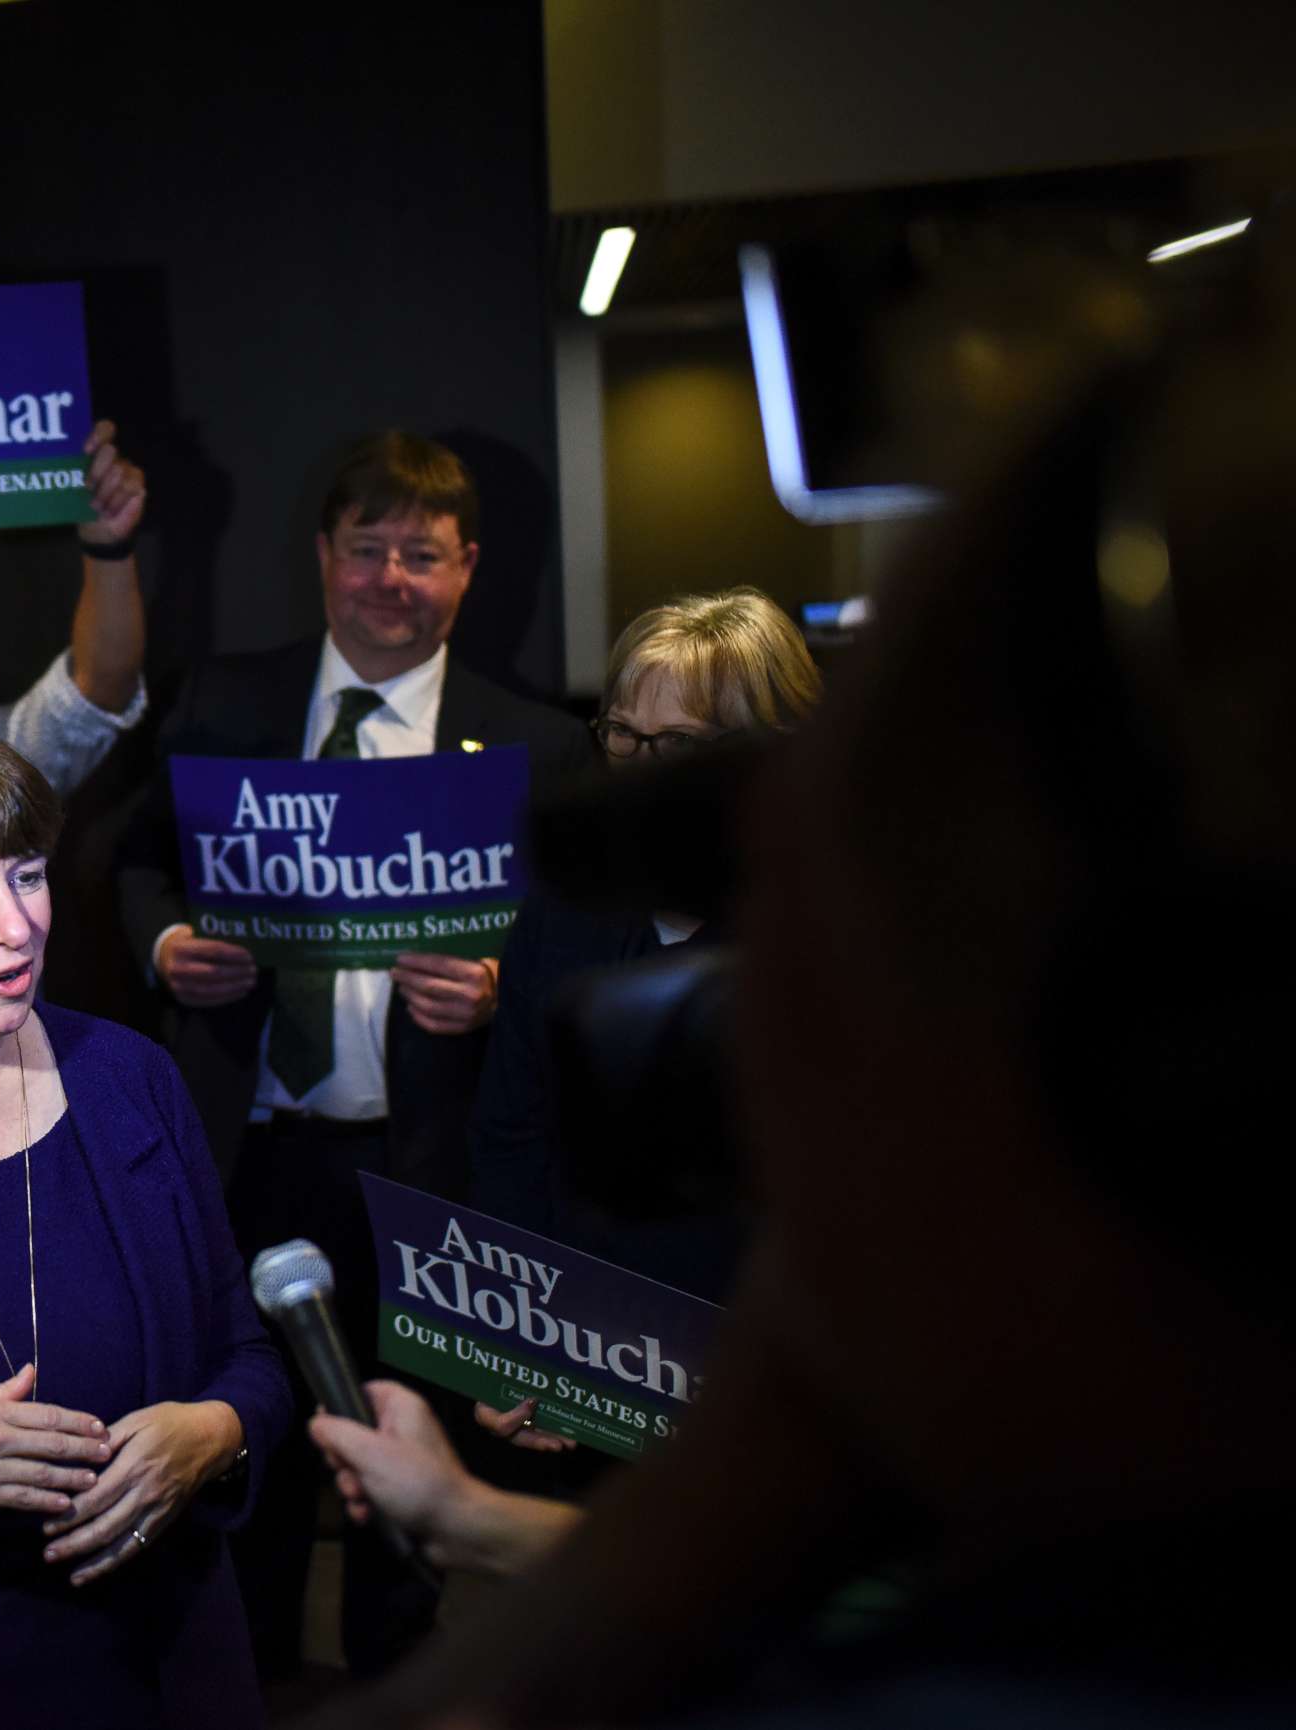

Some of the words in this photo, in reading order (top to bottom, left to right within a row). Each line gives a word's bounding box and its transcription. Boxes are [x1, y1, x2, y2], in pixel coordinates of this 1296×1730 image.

[233, 776, 340, 847] Amy
[194, 831, 515, 900] Klobuchar
[200, 913, 246, 937] OUR
[250, 916, 334, 942] UNITED
[339, 917, 418, 942] STATES
[437, 1217, 564, 1305] Amy
[392, 1239, 700, 1404] Klobuch
[393, 1313, 448, 1353] OUR
[454, 1335, 550, 1390] UNITED
[555, 1375, 648, 1430] STATES
